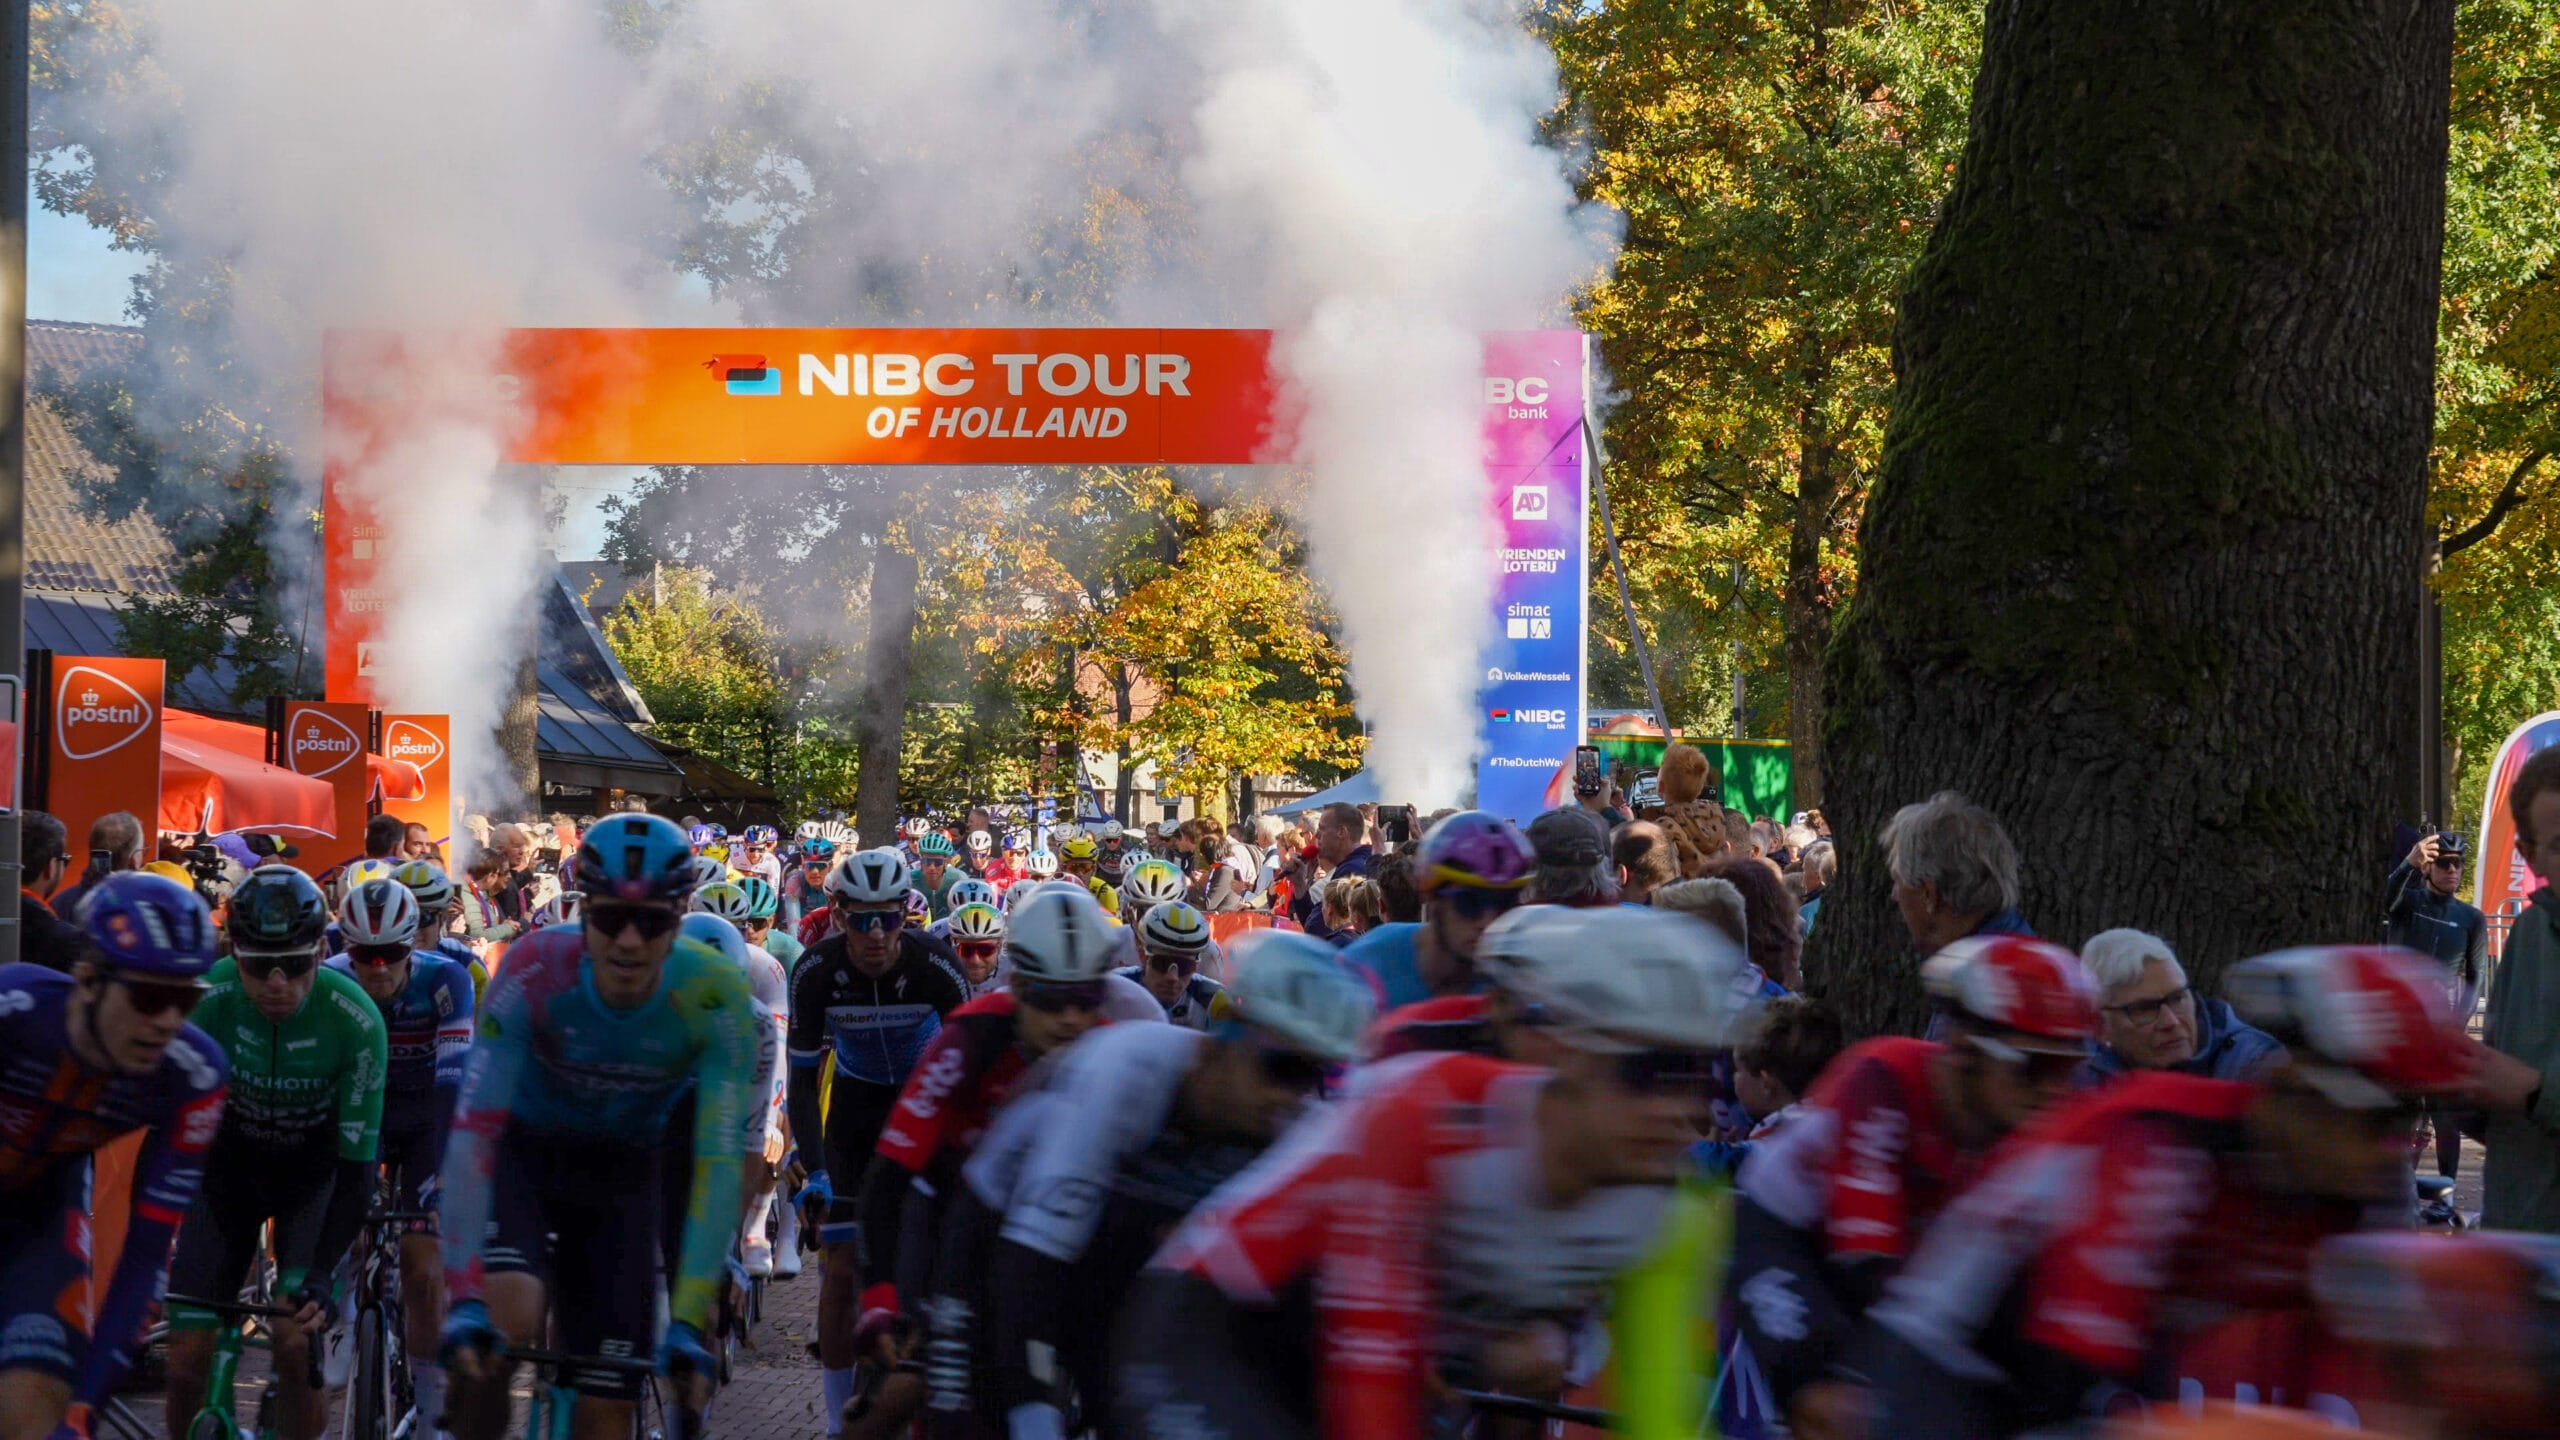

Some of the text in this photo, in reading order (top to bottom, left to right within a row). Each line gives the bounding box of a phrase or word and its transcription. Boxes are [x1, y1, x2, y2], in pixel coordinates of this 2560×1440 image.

[798, 353, 1192, 397] NIBC TOUR
[1484, 377, 1548, 405] BC
[1508, 406, 1548, 419] bank
[866, 406, 1128, 438] OF HOLLAND
[1515, 492, 1546, 512] AD
[352, 524, 386, 537] sima
[1495, 549, 1566, 561] VRIENDEN
[1503, 561, 1557, 574] LOTERIJ
[1507, 602, 1551, 617] simac
[1504, 671, 1571, 681] VolkerWessels
[67, 703, 139, 728] postnl
[1515, 709, 1566, 723] NIBC
[296, 735, 351, 756] postnl
[391, 742, 437, 759] postnl
[2507, 847, 2527, 892] NIB
[439, 1035, 470, 1044] OUDAL
[229, 1064, 331, 1091] ARKHOTE
